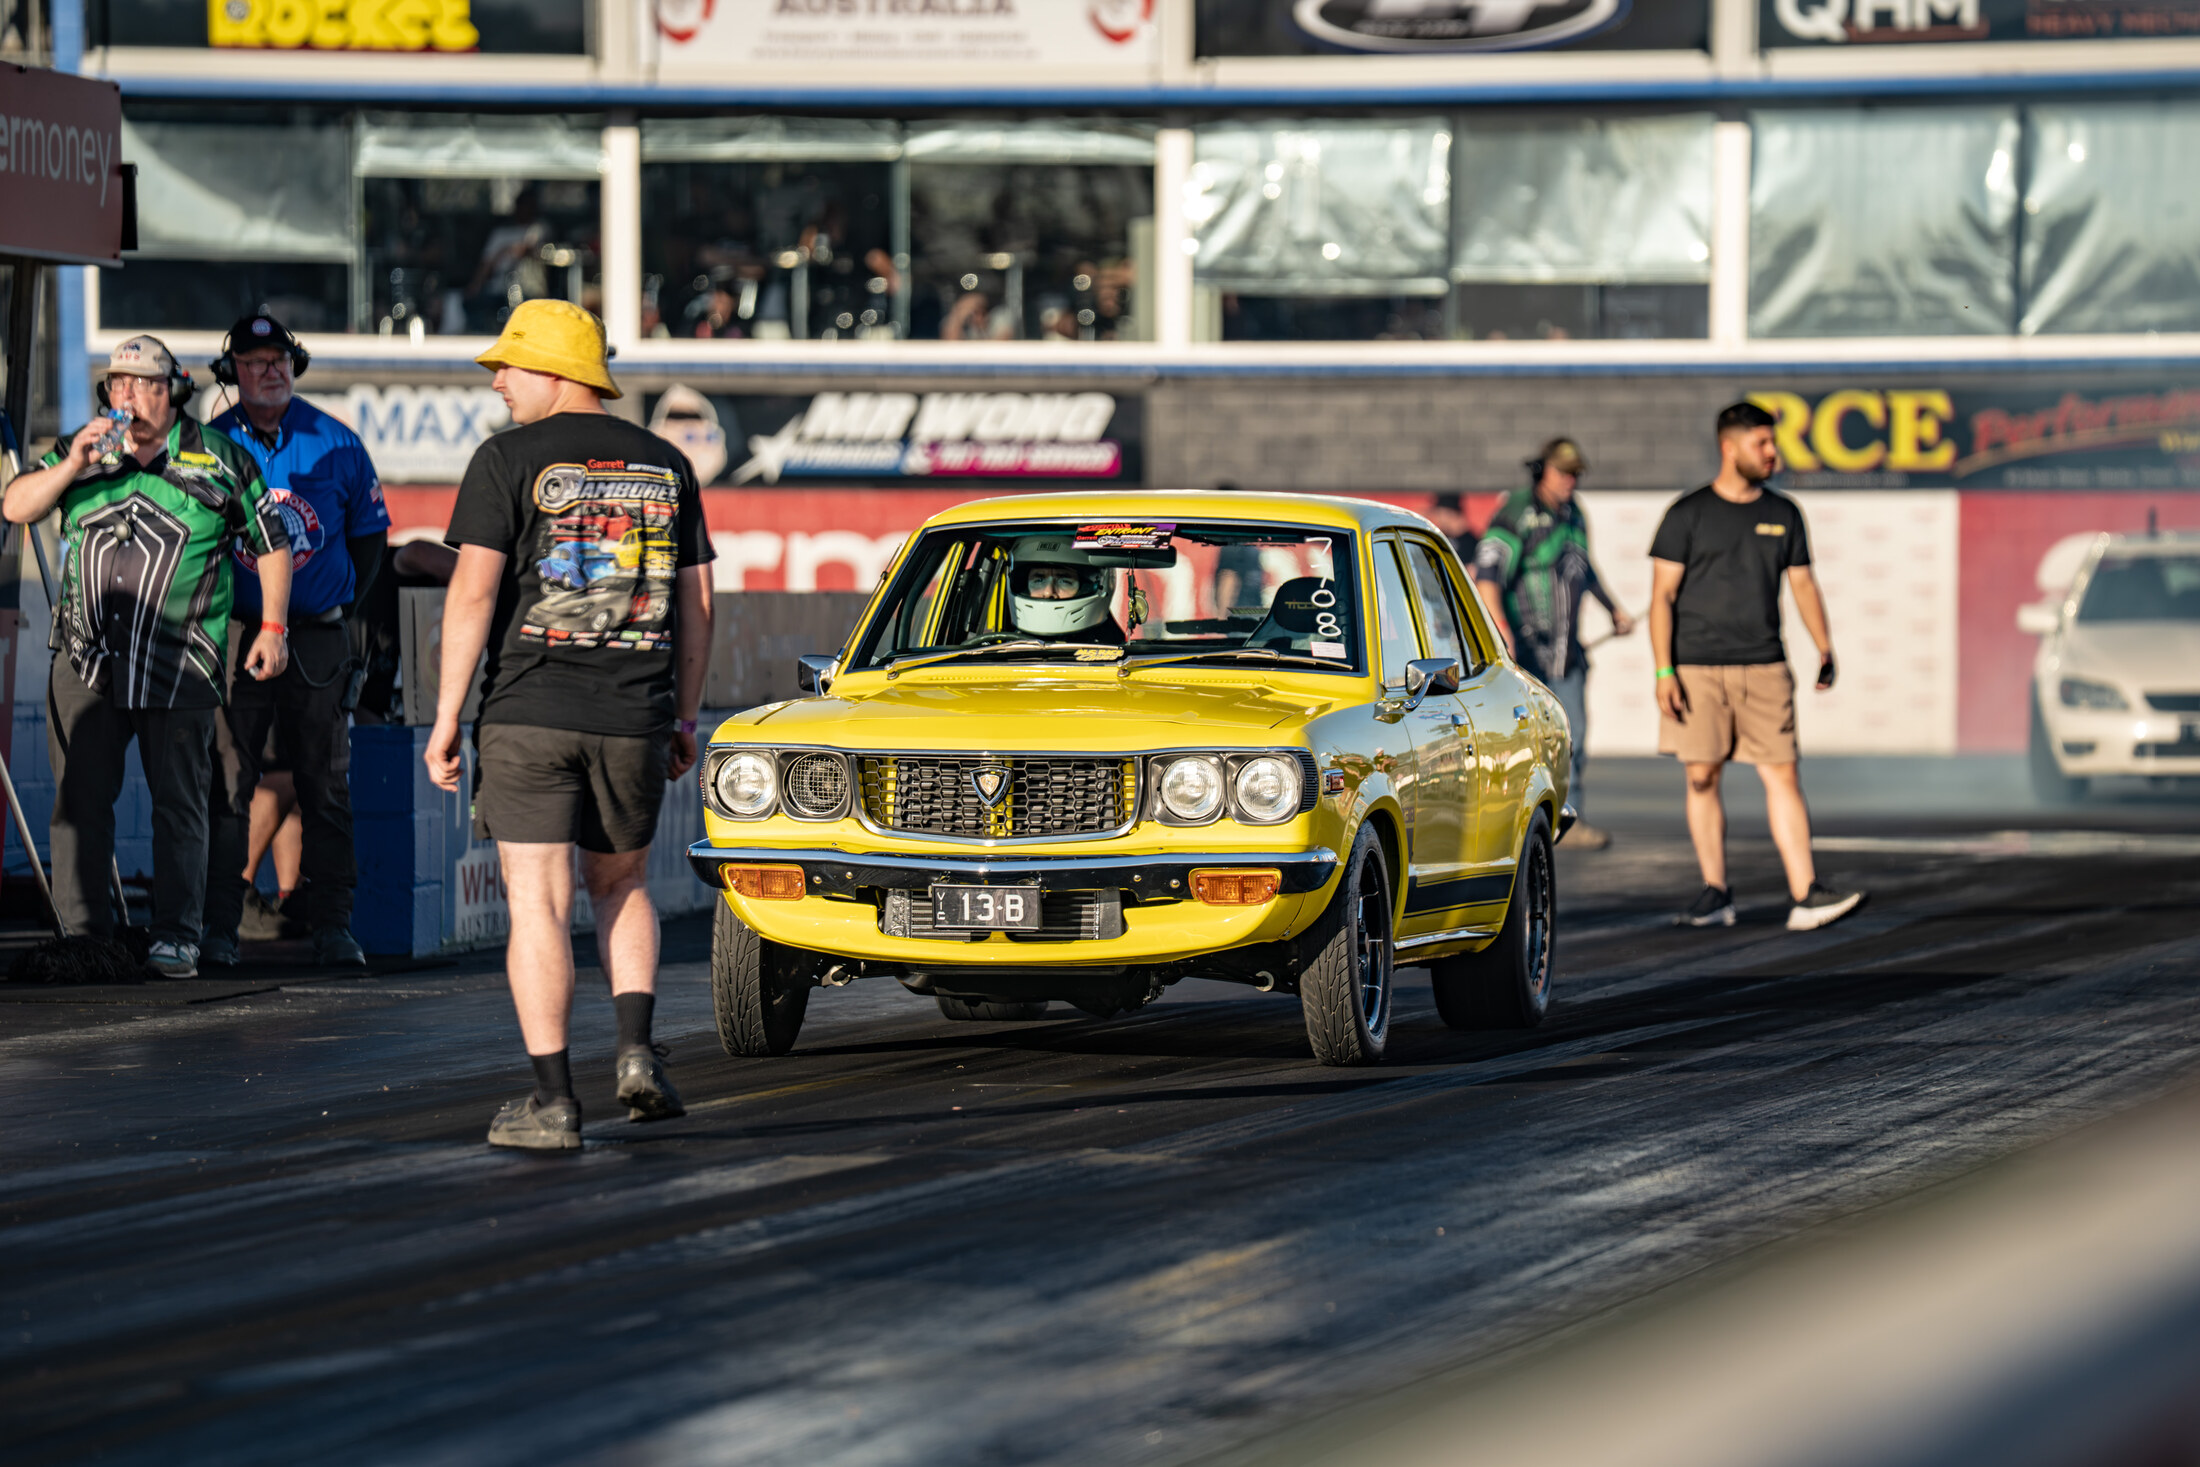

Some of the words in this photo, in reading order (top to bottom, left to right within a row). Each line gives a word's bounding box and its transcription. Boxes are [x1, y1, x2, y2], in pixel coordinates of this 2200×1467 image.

[355, 399, 482, 446] MAX
[587, 458, 625, 469] Garrett
[1094, 527, 1157, 536] ENTRANT
[644, 553, 678, 570] 35
[936, 891, 946, 920] VIC
